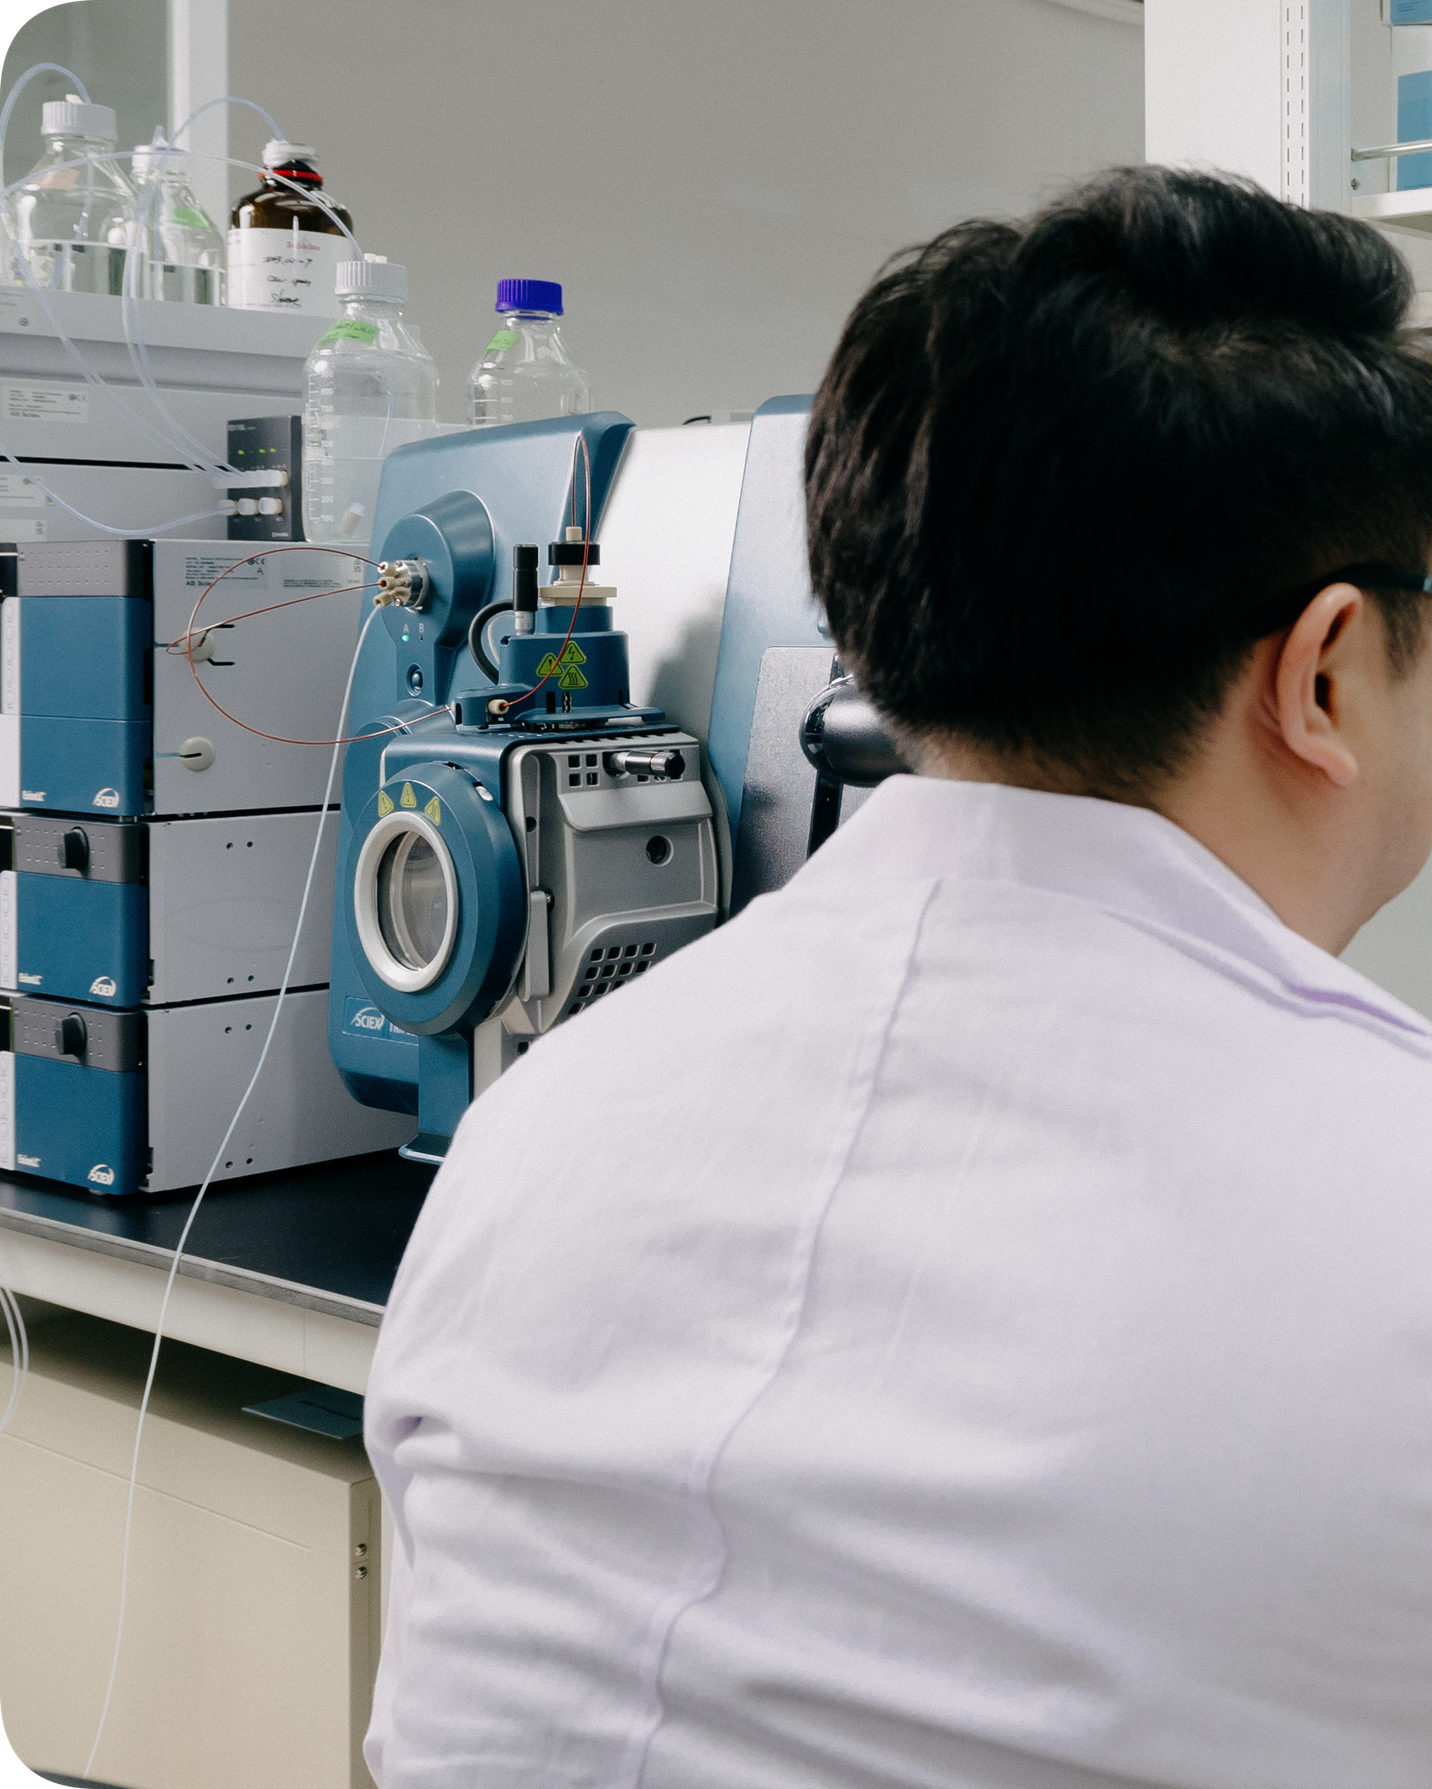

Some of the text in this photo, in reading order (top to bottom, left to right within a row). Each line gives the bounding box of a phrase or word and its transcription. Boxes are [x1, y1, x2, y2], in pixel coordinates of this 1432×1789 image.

[402, 622, 425, 634] A B
[352, 1009, 384, 1031] SCIEX
